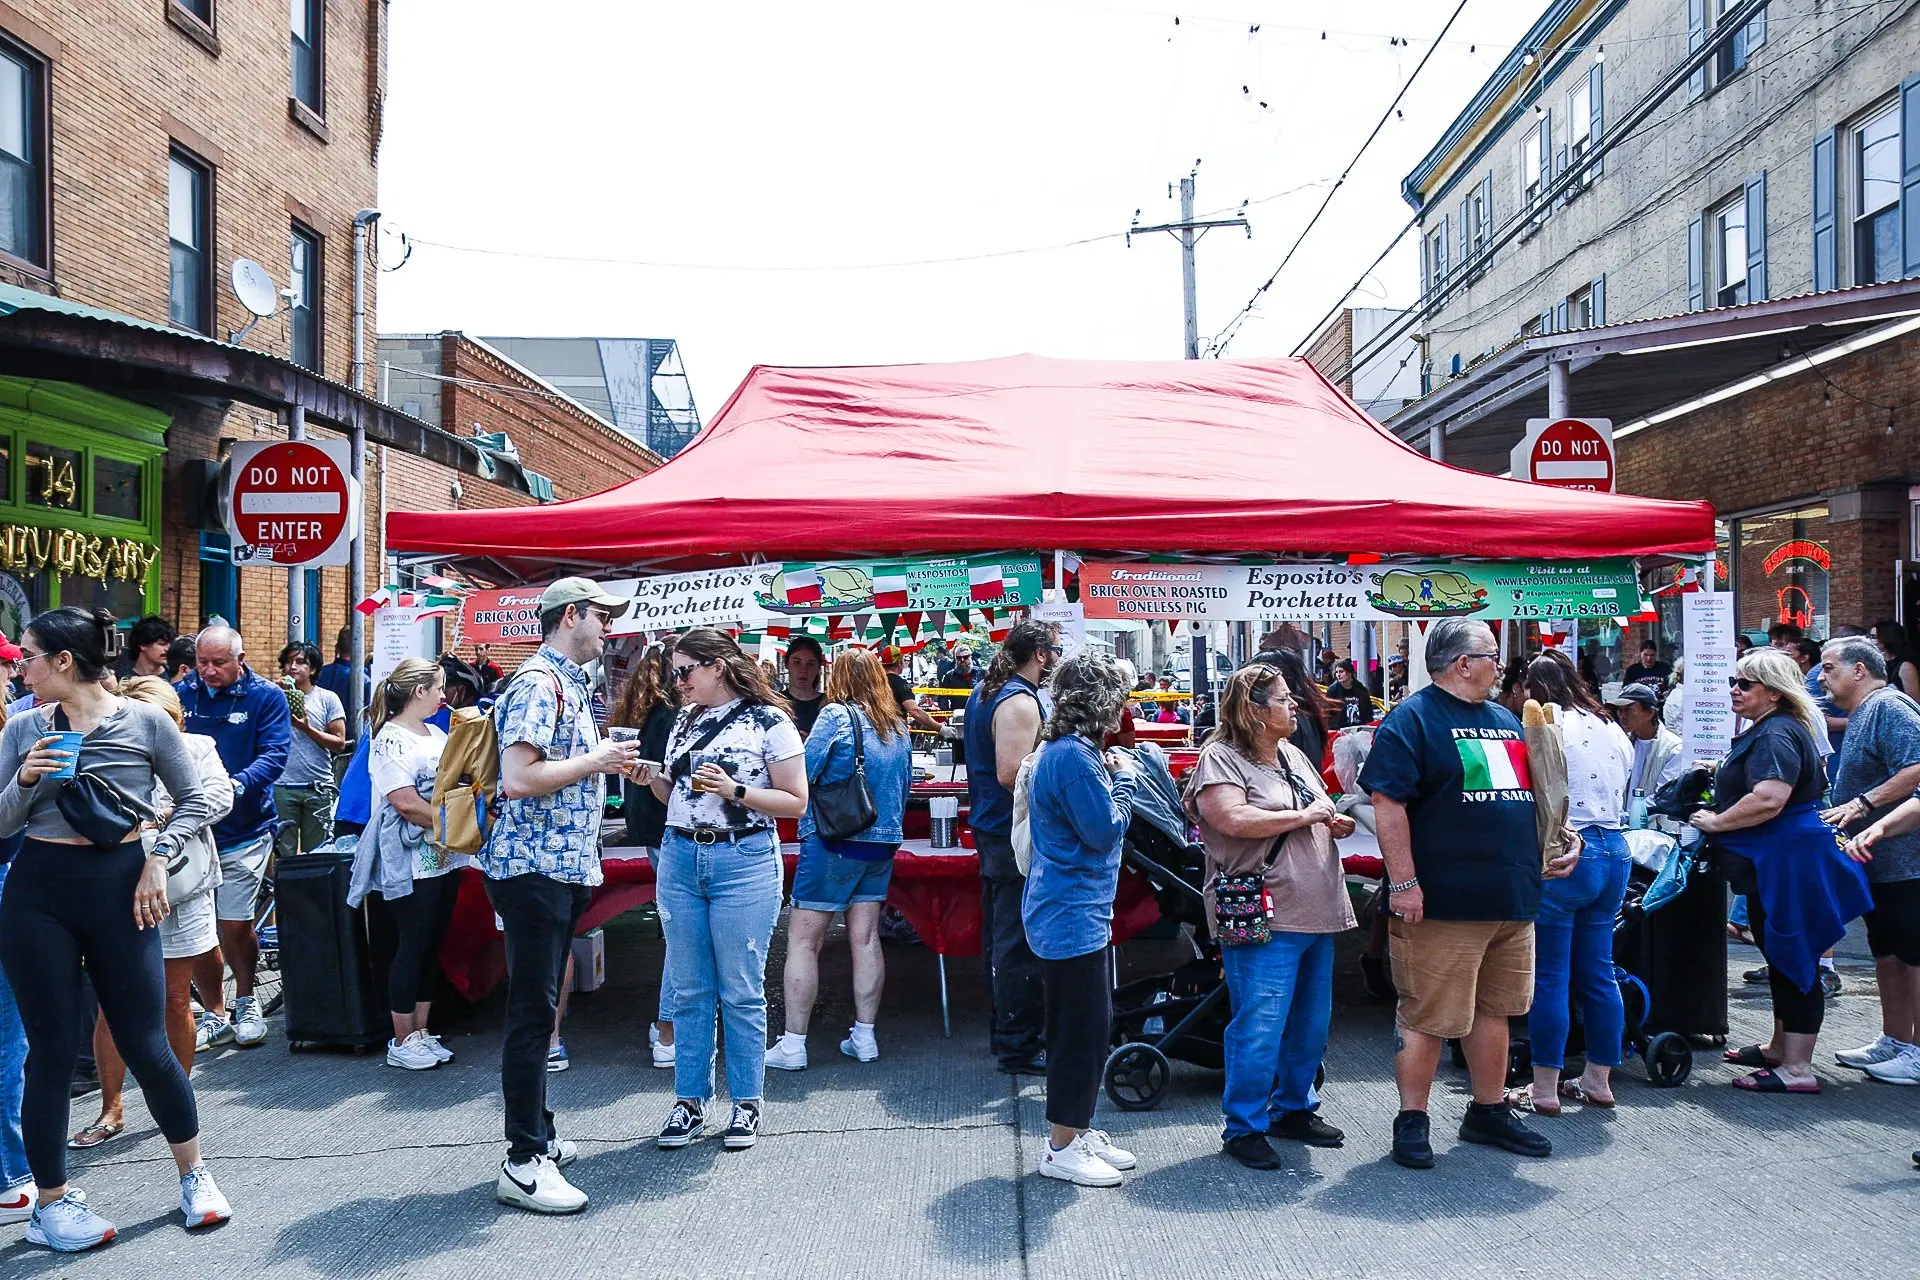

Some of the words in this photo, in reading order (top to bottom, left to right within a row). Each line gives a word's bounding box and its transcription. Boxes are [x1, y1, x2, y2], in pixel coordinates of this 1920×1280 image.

[1541, 440, 1562, 455] DO
[1571, 440, 1599, 455] NOT
[251, 467, 277, 485] DO
[291, 466, 331, 485] NOT
[258, 522, 322, 540] ENTER
[1111, 569, 1203, 581] Traditional
[1526, 565, 1556, 574] Visit
[1246, 566, 1364, 590] Esposito's
[633, 572, 753, 600] Esposito's
[1090, 585, 1129, 597] BRICK
[1132, 585, 1167, 598] OVEN
[1171, 586, 1228, 599] ROASTED
[1246, 590, 1358, 608] Porchetta
[632, 595, 745, 620] Porchetta
[1119, 601, 1181, 613] BONELESS
[1186, 602, 1207, 613] PIG
[1512, 602, 1619, 616] 215-271-8418
[475, 610, 514, 623] BRICK
[518, 609, 540, 621] OV
[642, 618, 695, 629] ITALIAN
[703, 613, 741, 622] STYLE
[502, 624, 542, 637] BONEL
[1451, 728, 1478, 738] IT'S
[1480, 728, 1520, 739] GRAVY
[1462, 791, 1497, 802] NOT
[1501, 790, 1534, 802] SAUC
